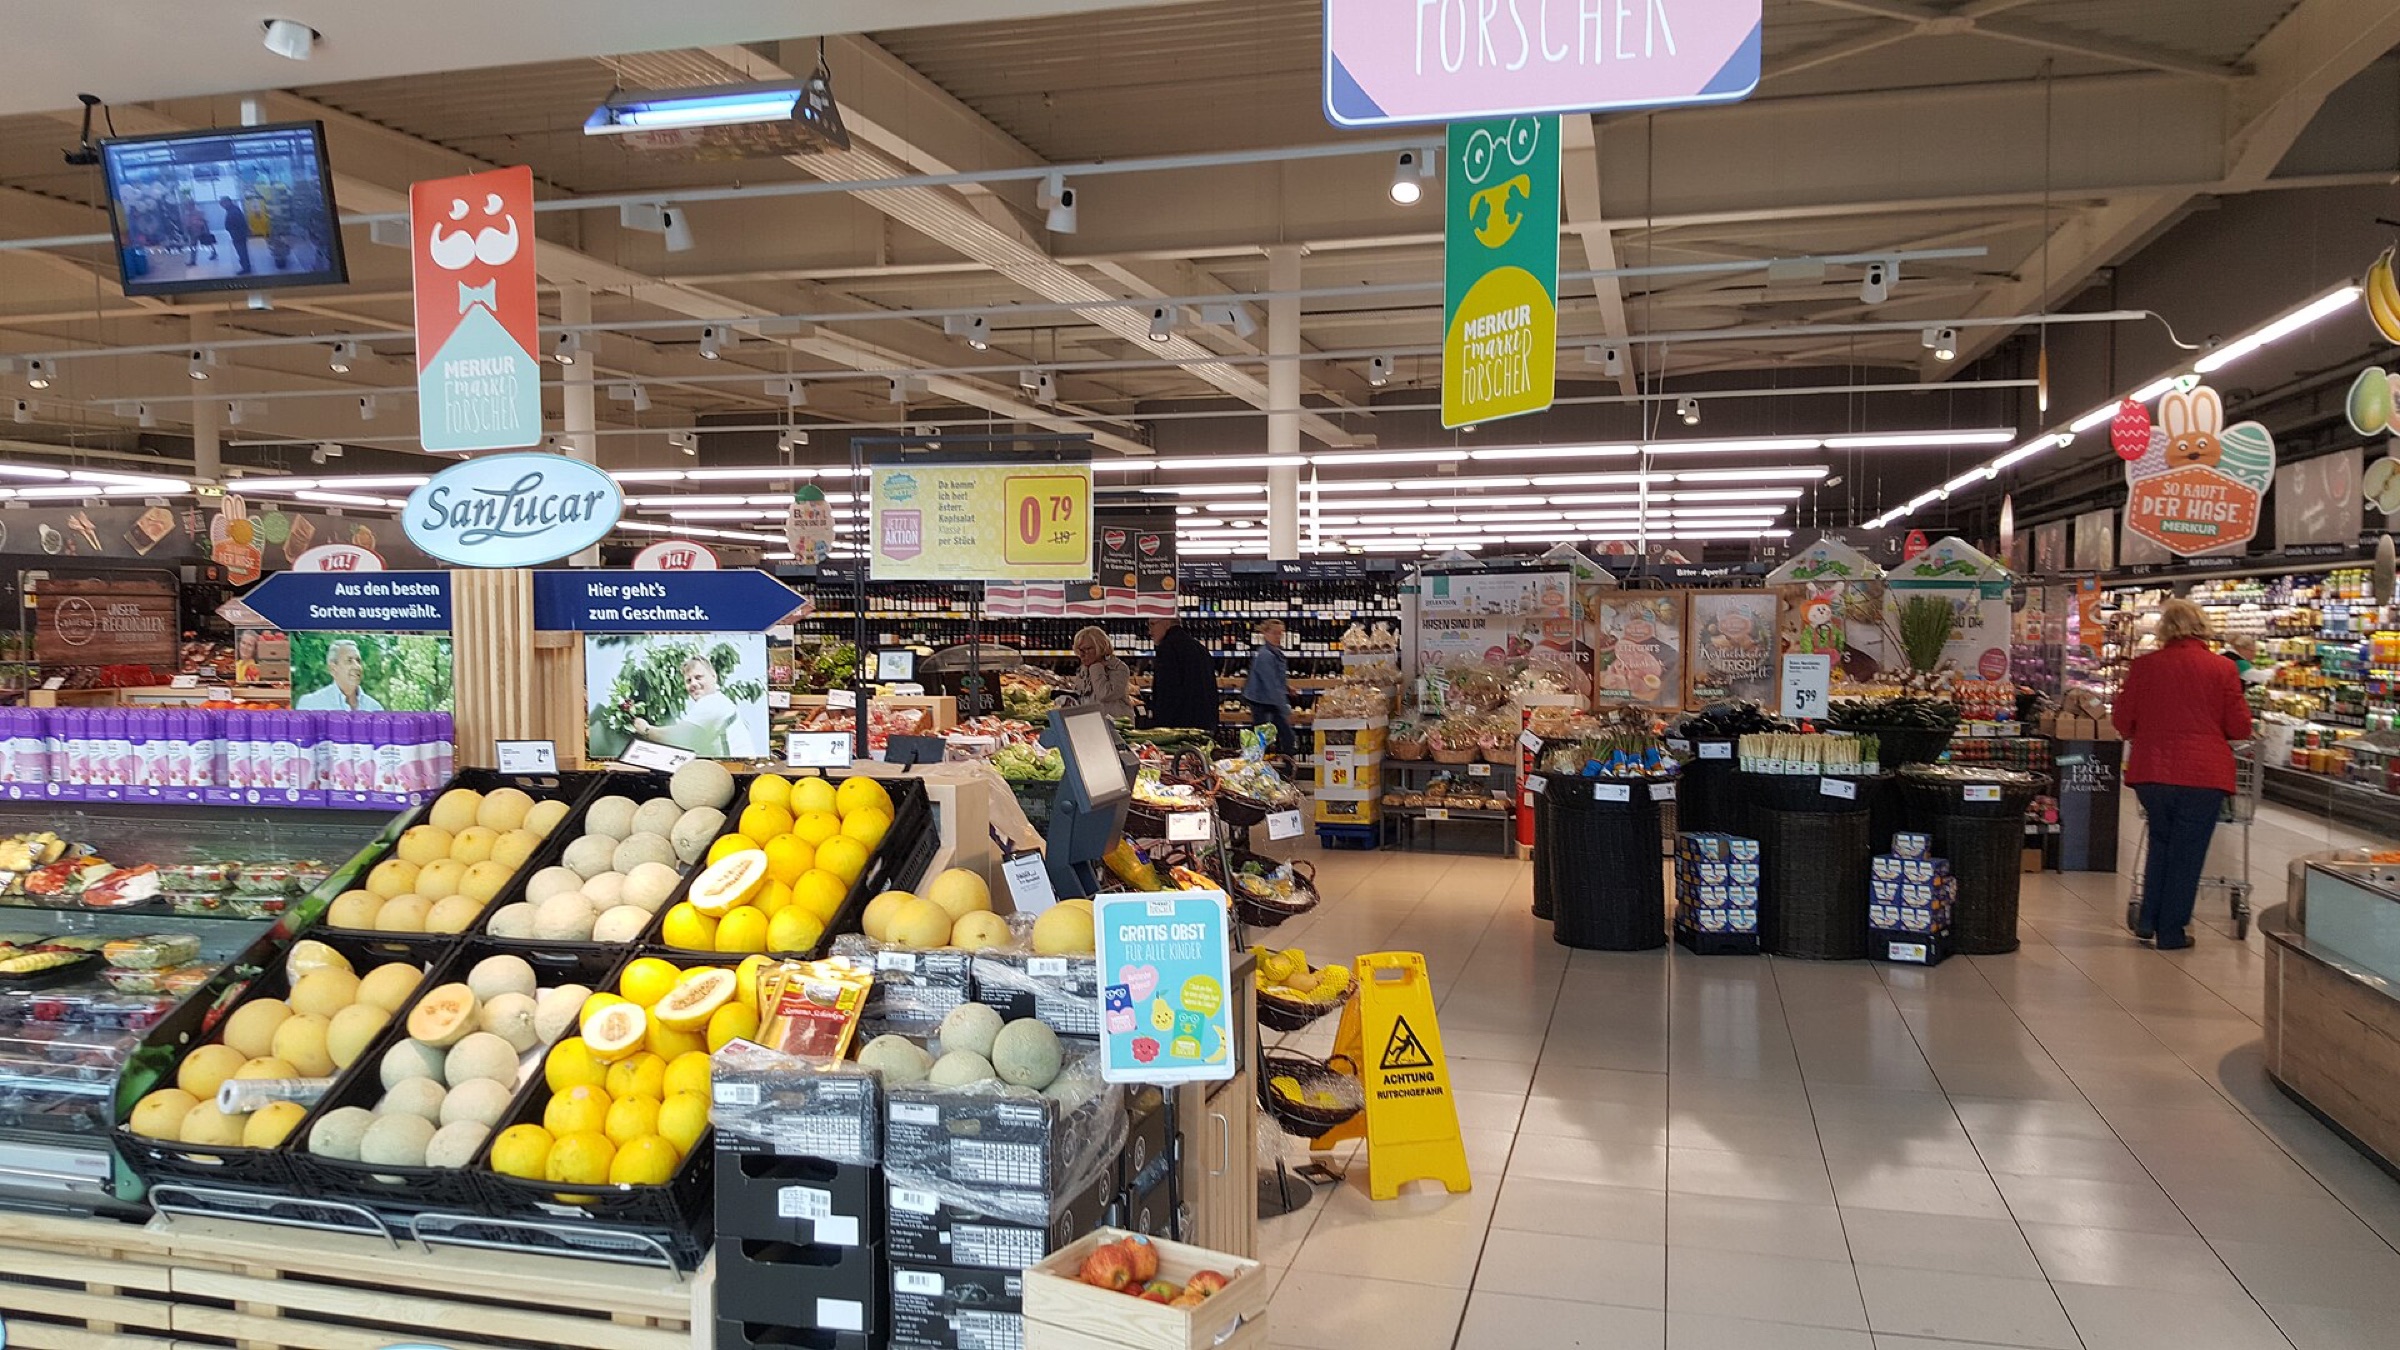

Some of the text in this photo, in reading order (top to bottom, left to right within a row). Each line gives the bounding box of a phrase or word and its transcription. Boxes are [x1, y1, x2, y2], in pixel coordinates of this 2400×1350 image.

[1463, 304, 1531, 342] MERKUR
[1472, 330, 1520, 361] markt
[444, 355, 516, 380] MERKUR
[1461, 328, 1532, 406] FORSCHER
[444, 376, 521, 435] FORSCHER
[2162, 480, 2229, 501] SO KAUFT
[421, 471, 605, 546] SanLucar
[2141, 495, 2181, 518] DER
[885, 518, 919, 531] JETZT IN
[1018, 495, 1073, 545] 0 79
[2161, 519, 2218, 536] MERKUR
[884, 530, 919, 546] AKTION
[334, 581, 441, 596] Aus den besten
[587, 582, 667, 600] Hier geht's
[309, 604, 442, 621] Sorten ausgewählt.
[588, 605, 710, 620] zum Geschmack.
[1421, 619, 1450, 630] HASEN
[1721, 659, 1757, 672] FRISCH
[958, 694, 995, 702] SAER
[959, 701, 994, 710] KRUT
[1119, 923, 1206, 942] GRATIS OBST
[1125, 942, 1203, 962] FÜR ALLE KINDER
[1383, 1072, 1435, 1086] ACHTUNG
[1377, 1086, 1444, 1101] RUTSCHGEFAHR
